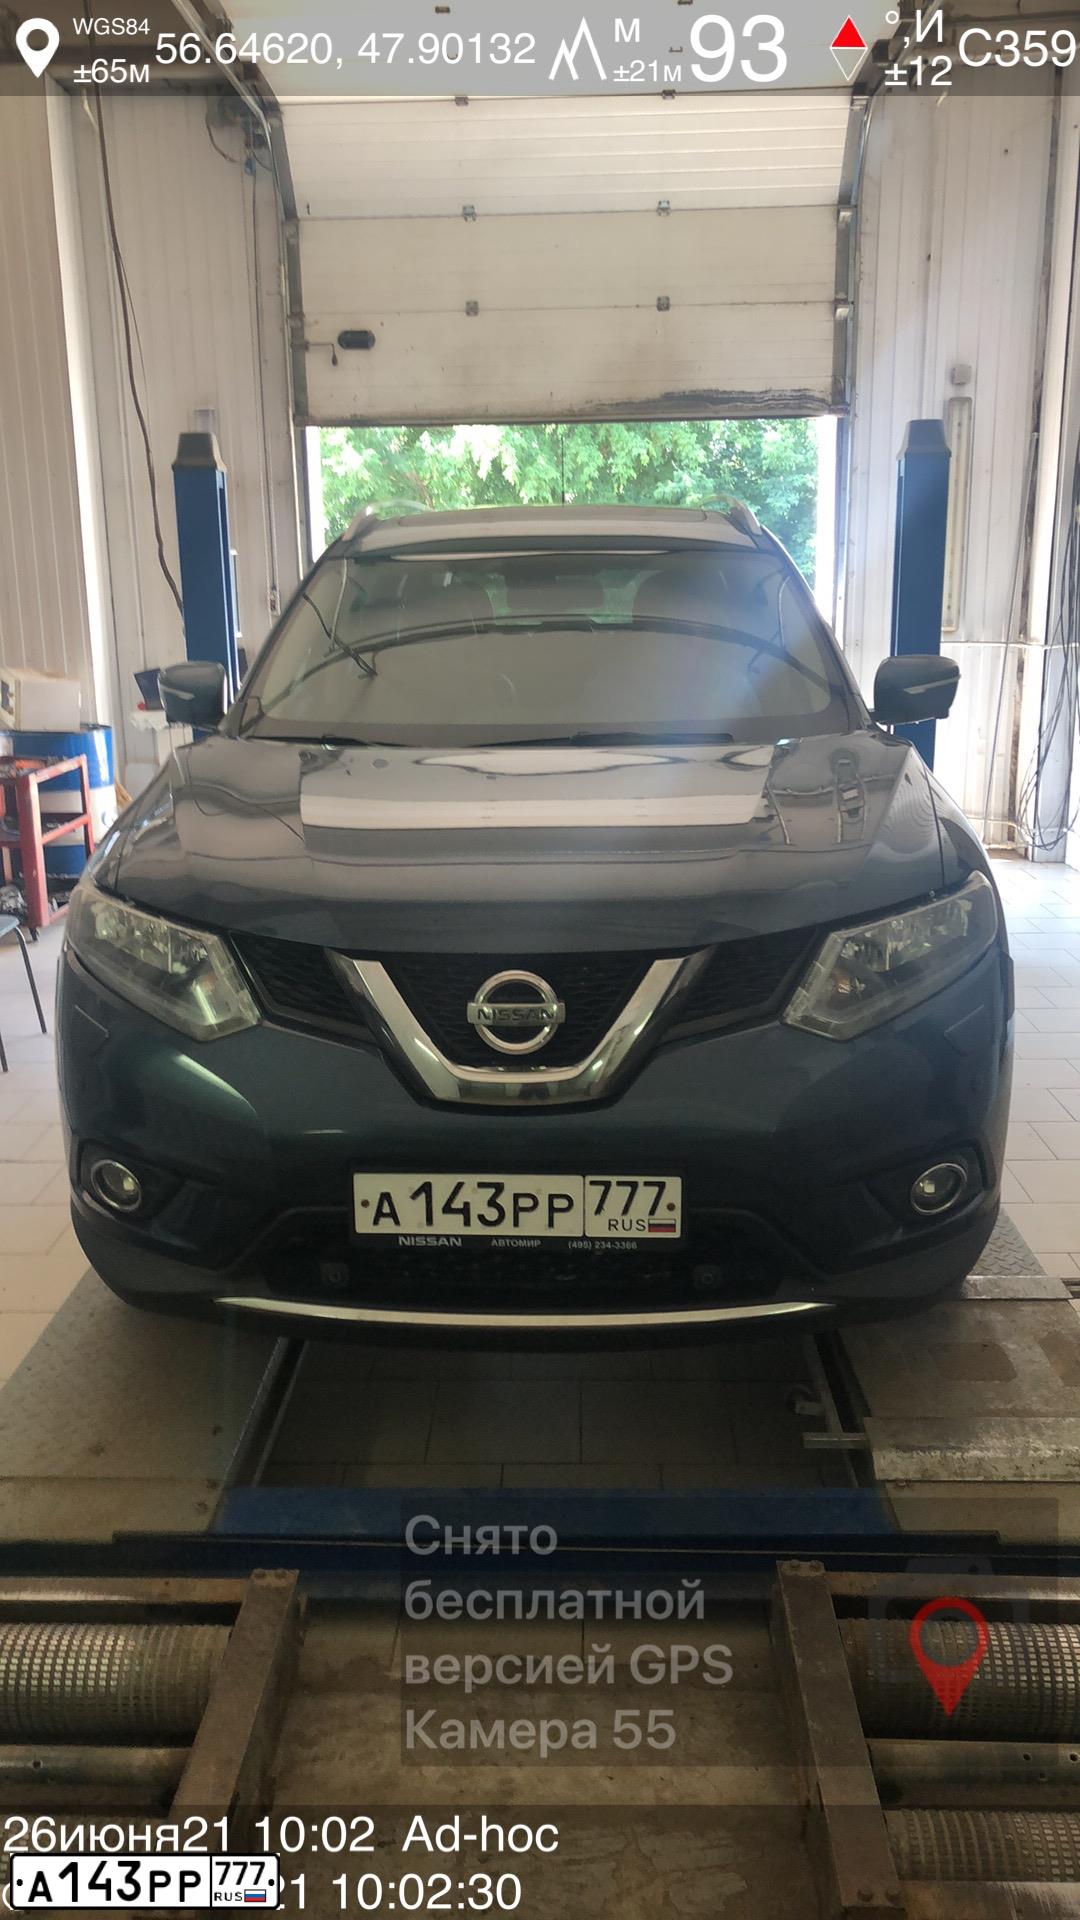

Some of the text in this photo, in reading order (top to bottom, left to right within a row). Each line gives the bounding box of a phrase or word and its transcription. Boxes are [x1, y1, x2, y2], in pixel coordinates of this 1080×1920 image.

[477, 1008, 554, 1021] NISSAN
[589, 1180, 667, 1216] 777
[607, 1218, 646, 1232] RUS
[398, 1236, 462, 1247] NISSAN
[490, 1239, 542, 1248] АВТОМИР
